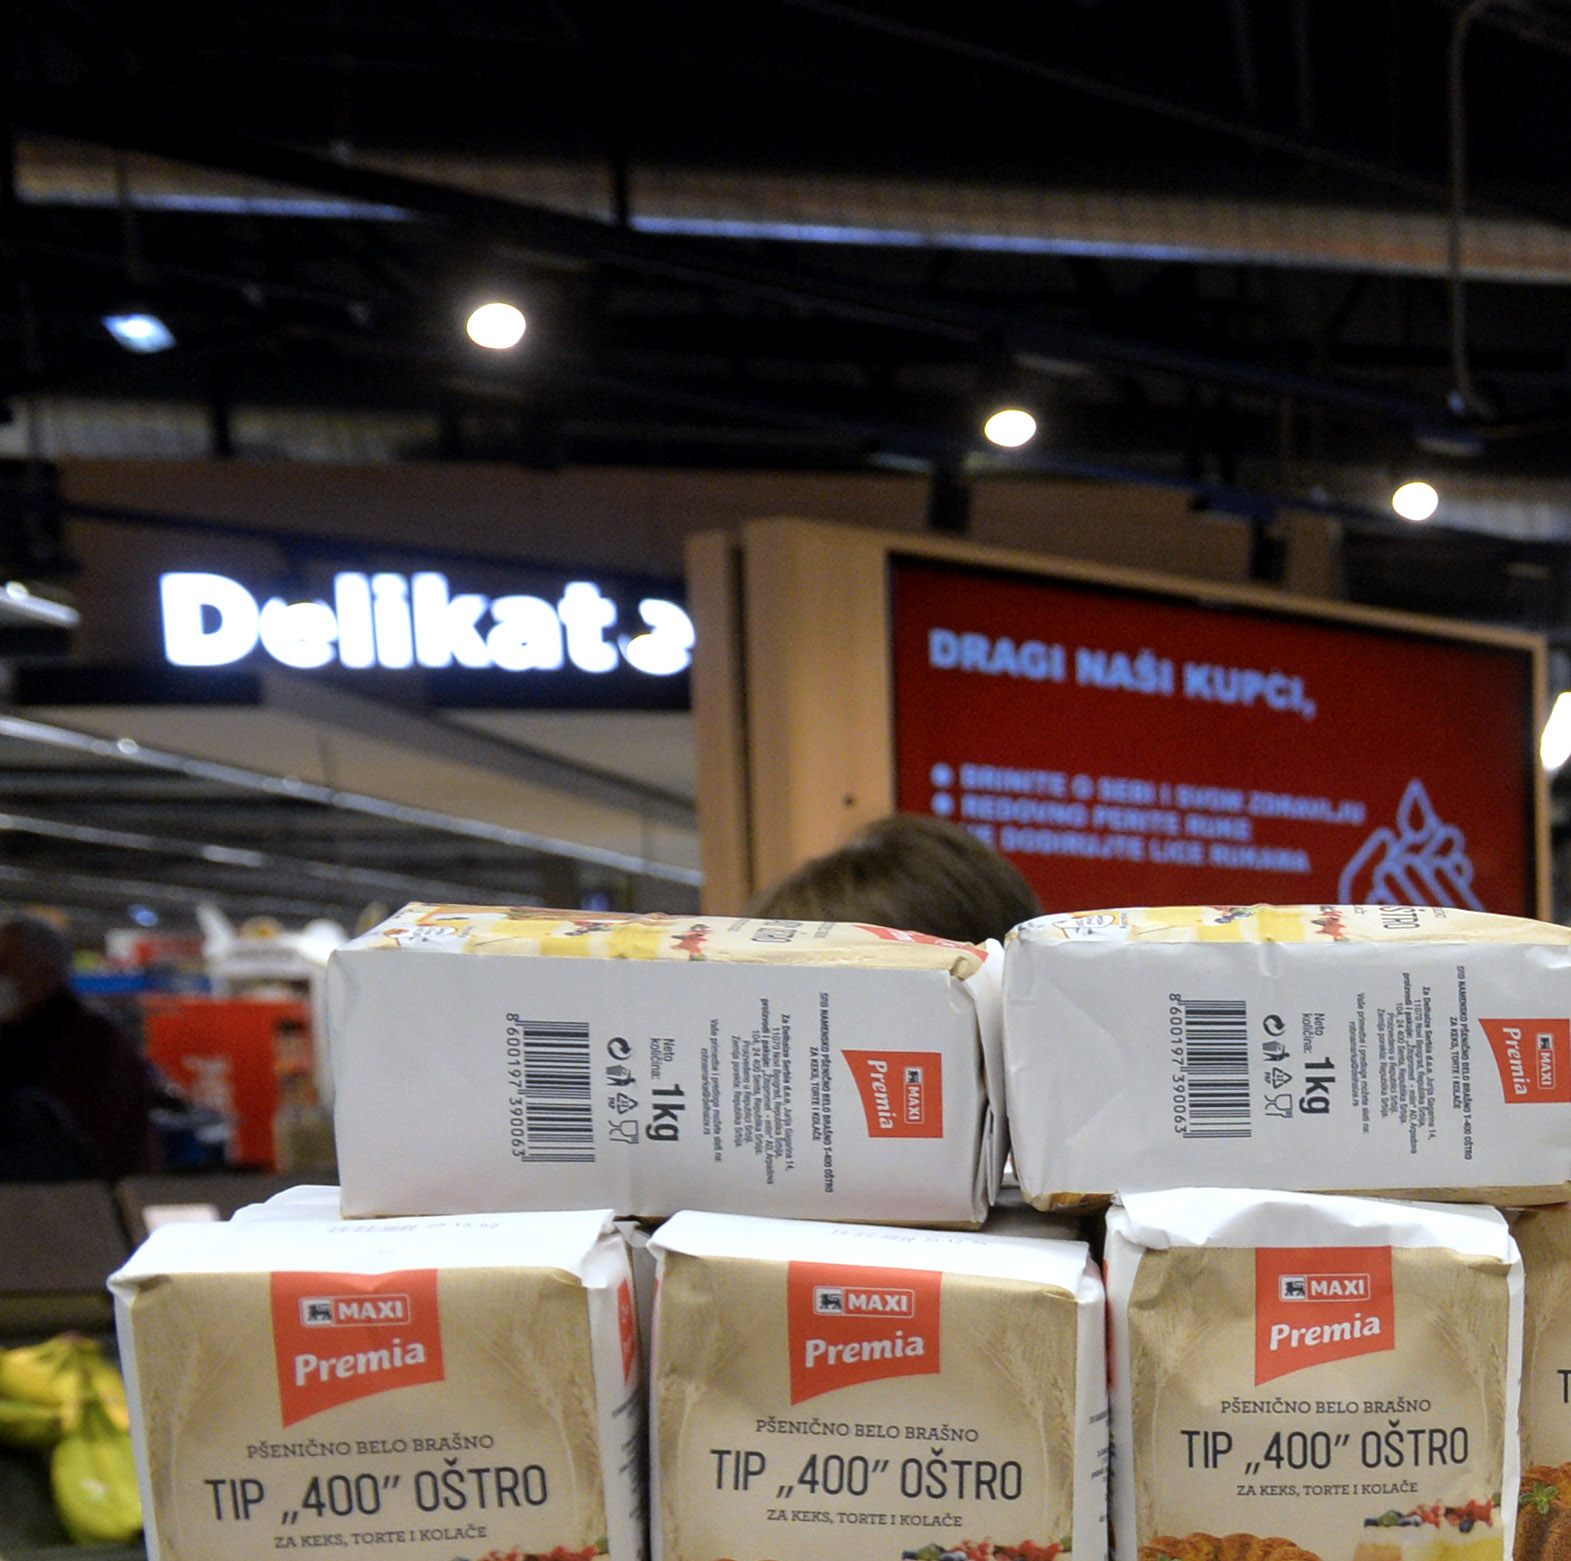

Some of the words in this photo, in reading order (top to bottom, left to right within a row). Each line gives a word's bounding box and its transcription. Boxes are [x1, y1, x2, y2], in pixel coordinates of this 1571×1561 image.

[929, 627, 1066, 683] DRAGI
[1075, 648, 1175, 695] NAŠI
[1302, 1013, 1312, 1054] količina:
[1314, 1013, 1325, 1037] Neto
[650, 1037, 662, 1081] količina:
[664, 1038, 676, 1062] Neto
[1502, 1025, 1527, 1096] Premia
[1540, 1050, 1553, 1087] MAXI
[867, 1059, 897, 1129] Premia
[908, 1086, 920, 1120] MAXI
[1299, 1056, 1336, 1115] 1kg
[645, 1082, 686, 1142] 1kg
[338, 1299, 404, 1321] MAXI
[294, 1337, 427, 1387] Premia
[247, 1436, 352, 1460] PŠENIČNO
[356, 1438, 407, 1457] BELO
[412, 1431, 494, 1453] BRAŠNO
[204, 1477, 265, 1521] TIP
[414, 1457, 548, 1513] OŠTRO
[273, 1534, 298, 1549] ZA
[350, 1528, 406, 1547] TORTE
[419, 1525, 487, 1543] KOLAČE
